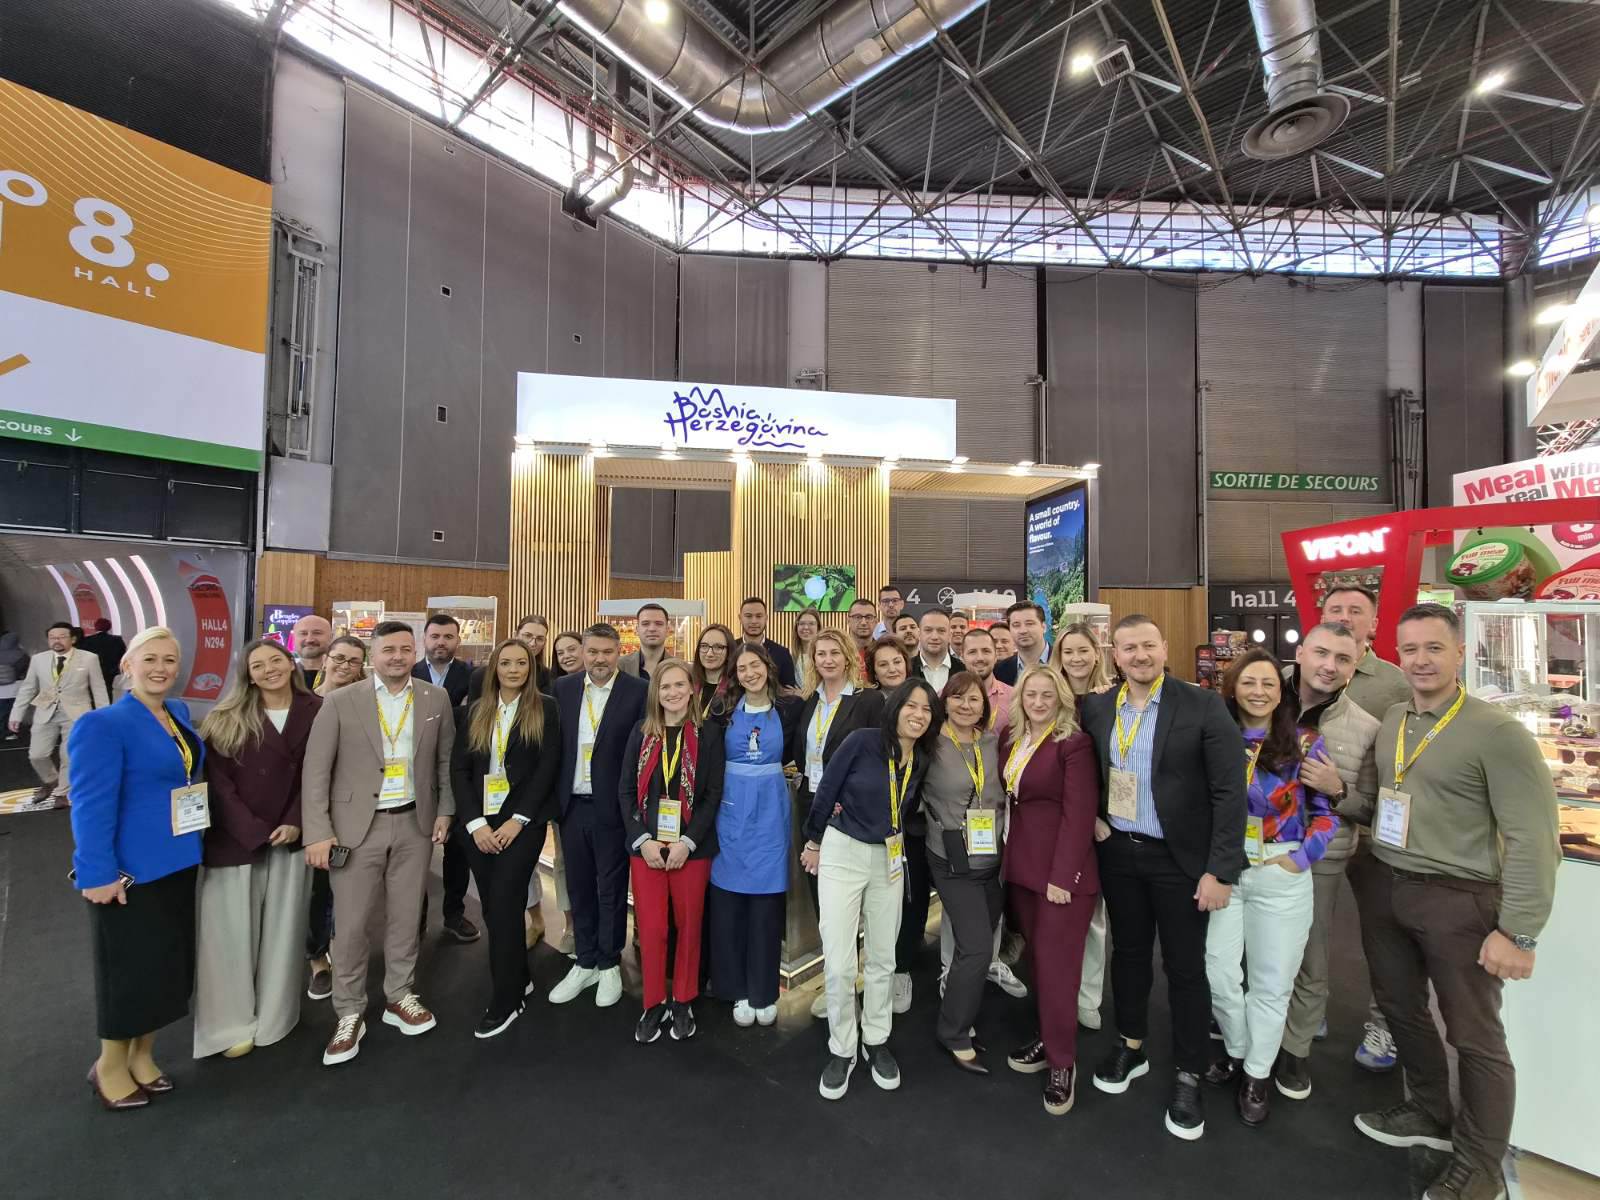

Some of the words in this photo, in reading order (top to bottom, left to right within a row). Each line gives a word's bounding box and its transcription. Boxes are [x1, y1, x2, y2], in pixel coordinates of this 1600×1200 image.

[74, 266, 156, 298] HALL
[0, 419, 53, 436] COURS
[663, 412, 829, 446] Herzegovina
[1213, 472, 1273, 488] SORTIE
[1277, 474, 1300, 489] DE
[1304, 475, 1379, 491] SECOURS
[1463, 463, 1546, 504] Meal
[1505, 484, 1549, 502] real
[1034, 507, 1051, 520] small
[1034, 519, 1051, 531] world
[1053, 515, 1060, 526] of
[906, 588, 921, 605] 4
[1230, 590, 1279, 608] hall
[1282, 590, 1297, 607] 4
[204, 636, 225, 649] N294
